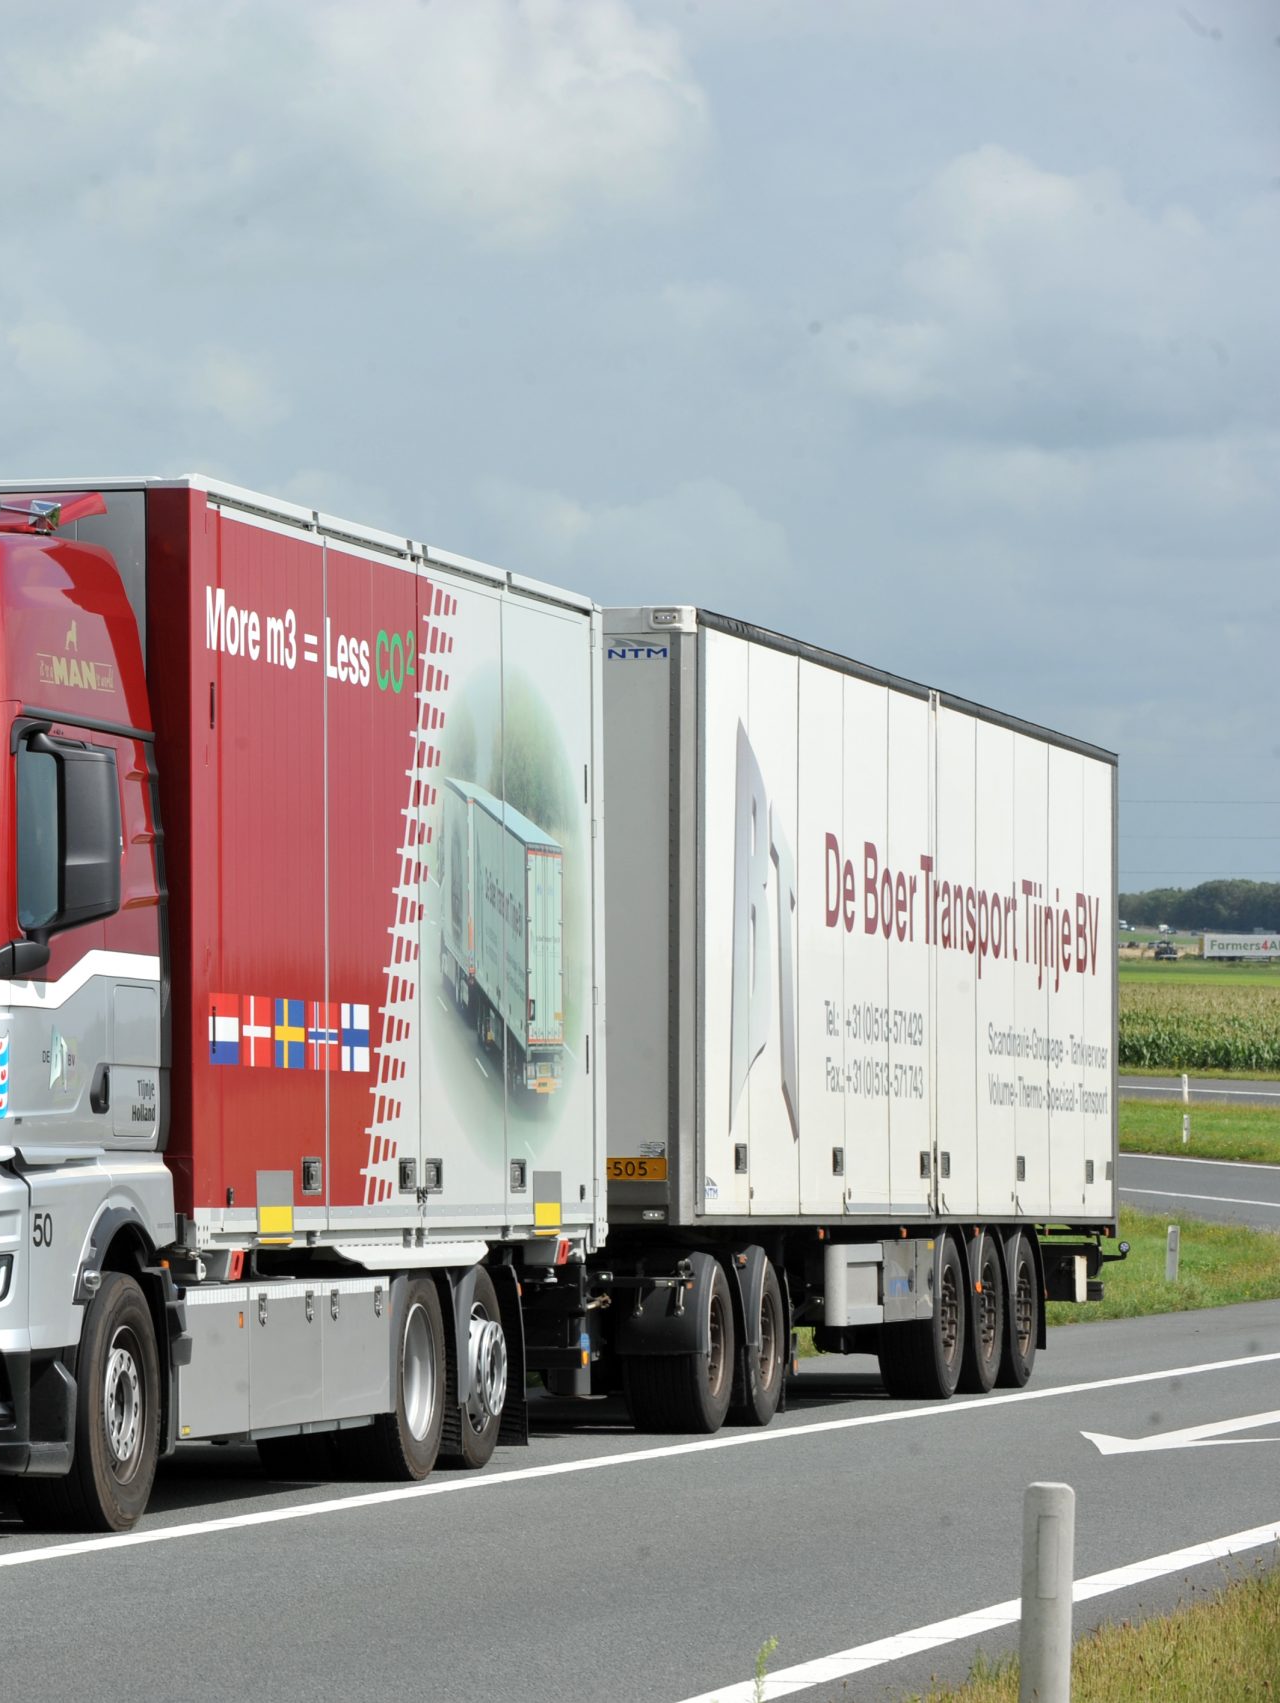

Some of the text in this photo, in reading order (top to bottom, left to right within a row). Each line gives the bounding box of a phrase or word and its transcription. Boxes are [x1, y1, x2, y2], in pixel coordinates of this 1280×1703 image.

[206, 585, 261, 661] More
[266, 608, 297, 670] m3
[325, 616, 370, 687] Less
[608, 648, 668, 659] NTM
[825, 832, 1099, 993] De Boer Transport Tijnje BV
[137, 1079, 155, 1098] Tijnje
[1079, 1082, 1108, 1121] Transport
[132, 1104, 156, 1122] Holland
[33, 1213, 53, 1247] 50
